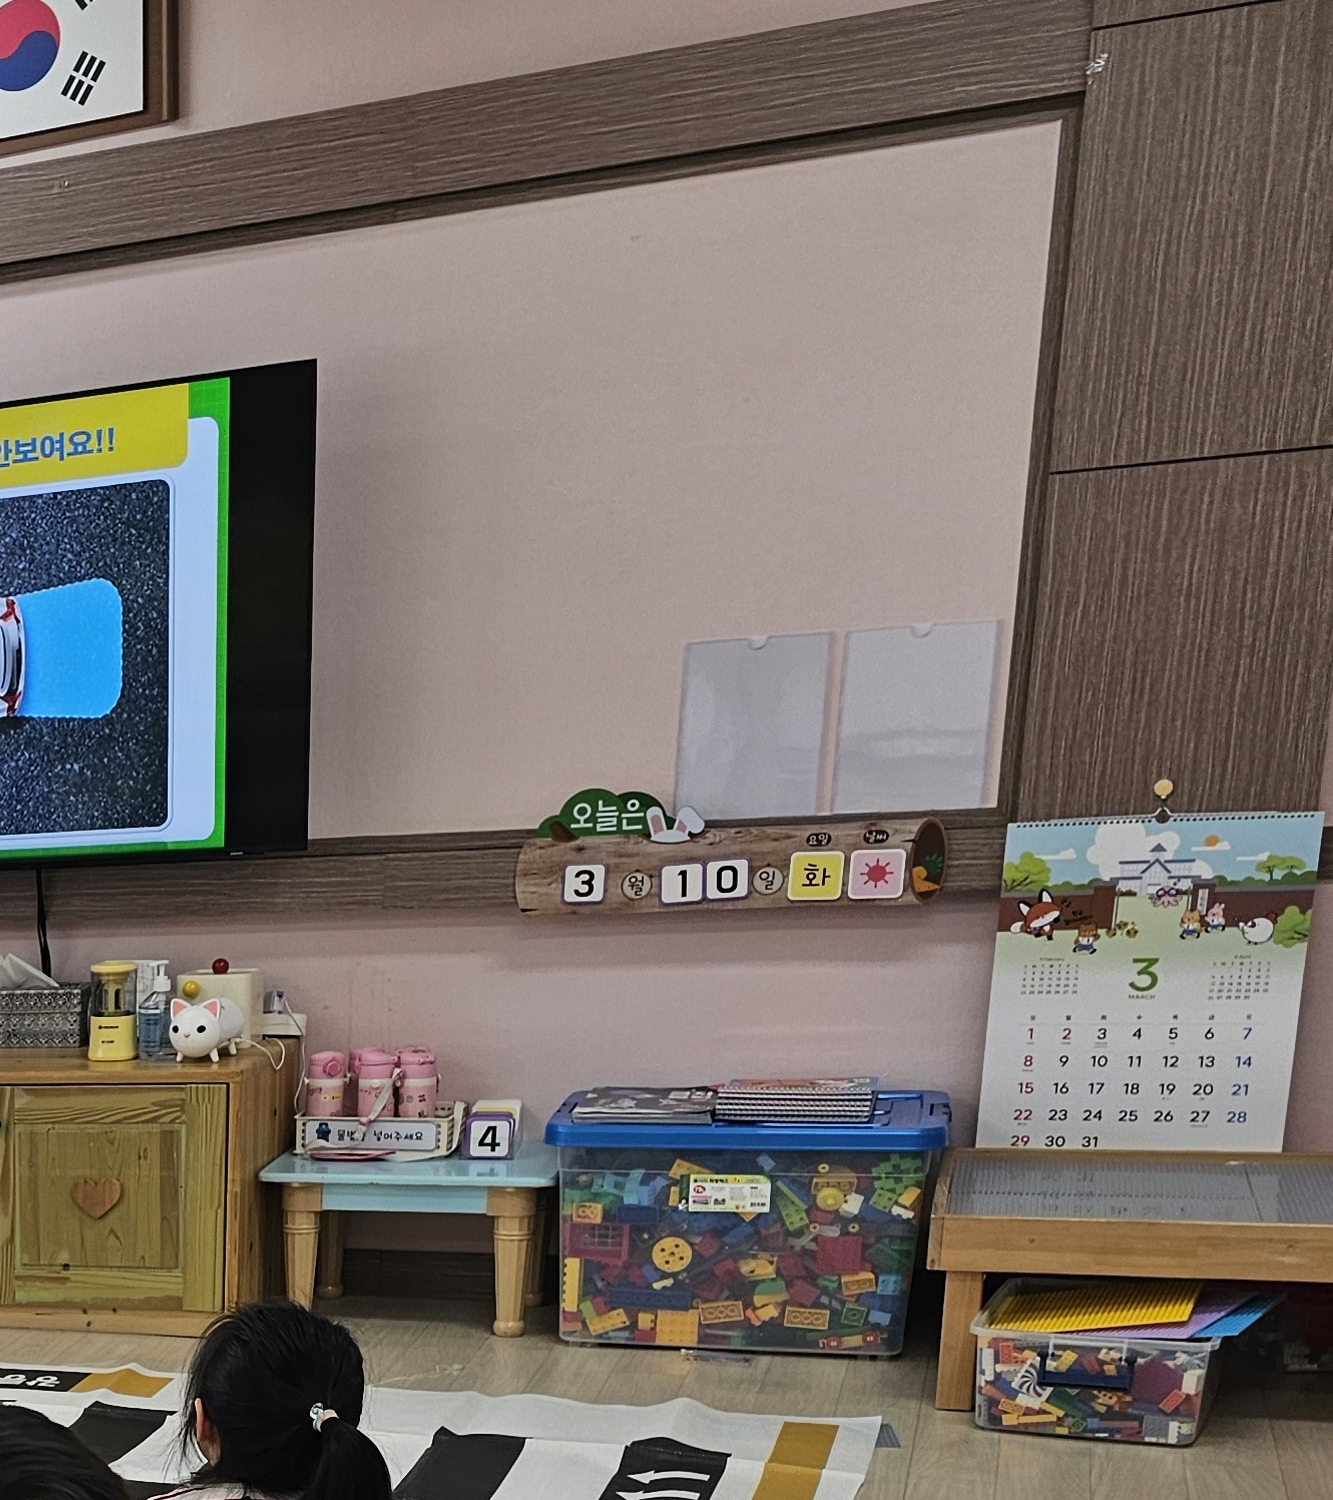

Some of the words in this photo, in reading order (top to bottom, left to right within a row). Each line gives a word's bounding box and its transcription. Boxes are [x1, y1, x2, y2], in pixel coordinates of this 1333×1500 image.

[570, 798, 644, 832] 오늘은
[808, 833, 831, 846] 요일
[865, 829, 888, 843] 날씨
[573, 869, 596, 898] 3
[628, 875, 647, 898] 월
[759, 870, 778, 892] 일
[801, 864, 831, 889] 화
[1128, 957, 1160, 992] 3
[1028, 1027, 1034, 1040] 1
[1062, 1027, 1072, 1040] 2
[1096, 1027, 1108, 1040] 3
[1132, 1027, 1142, 1040] 4
[1168, 1026, 1179, 1040] 5
[1204, 1027, 1215, 1041] 6
[1243, 1027, 1253, 1040] 7
[1023, 1054, 1034, 1068] 8
[1058, 1054, 1070, 1068] 9
[1090, 1054, 1109, 1068] 10
[1127, 1055, 1142, 1068] 11
[1162, 1055, 1180, 1068] 12
[1198, 1055, 1216, 1069] 13
[1235, 1055, 1252, 1069] 14
[1018, 1081, 1034, 1095] 15
[1052, 1082, 1070, 1095] 16
[1088, 1082, 1105, 1095] 17
[1123, 1082, 1140, 1096] 18
[1158, 1082, 1177, 1096] 19
[1192, 1083, 1214, 1096] 20
[1231, 1083, 1249, 1096] 21
[1013, 1108, 1033, 1121] 22
[1048, 1108, 1068, 1122] 23
[1082, 1109, 1103, 1122] 24
[1118, 1109, 1139, 1123] 25
[1153, 1109, 1174, 1123] 26
[1189, 1110, 1211, 1123] 27
[1226, 1111, 1247, 1124] 28
[477, 1125, 501, 1153] 4
[1010, 1134, 1030, 1147] 29
[1044, 1135, 1066, 1148] 30
[1081, 1135, 1099, 1148] 31
